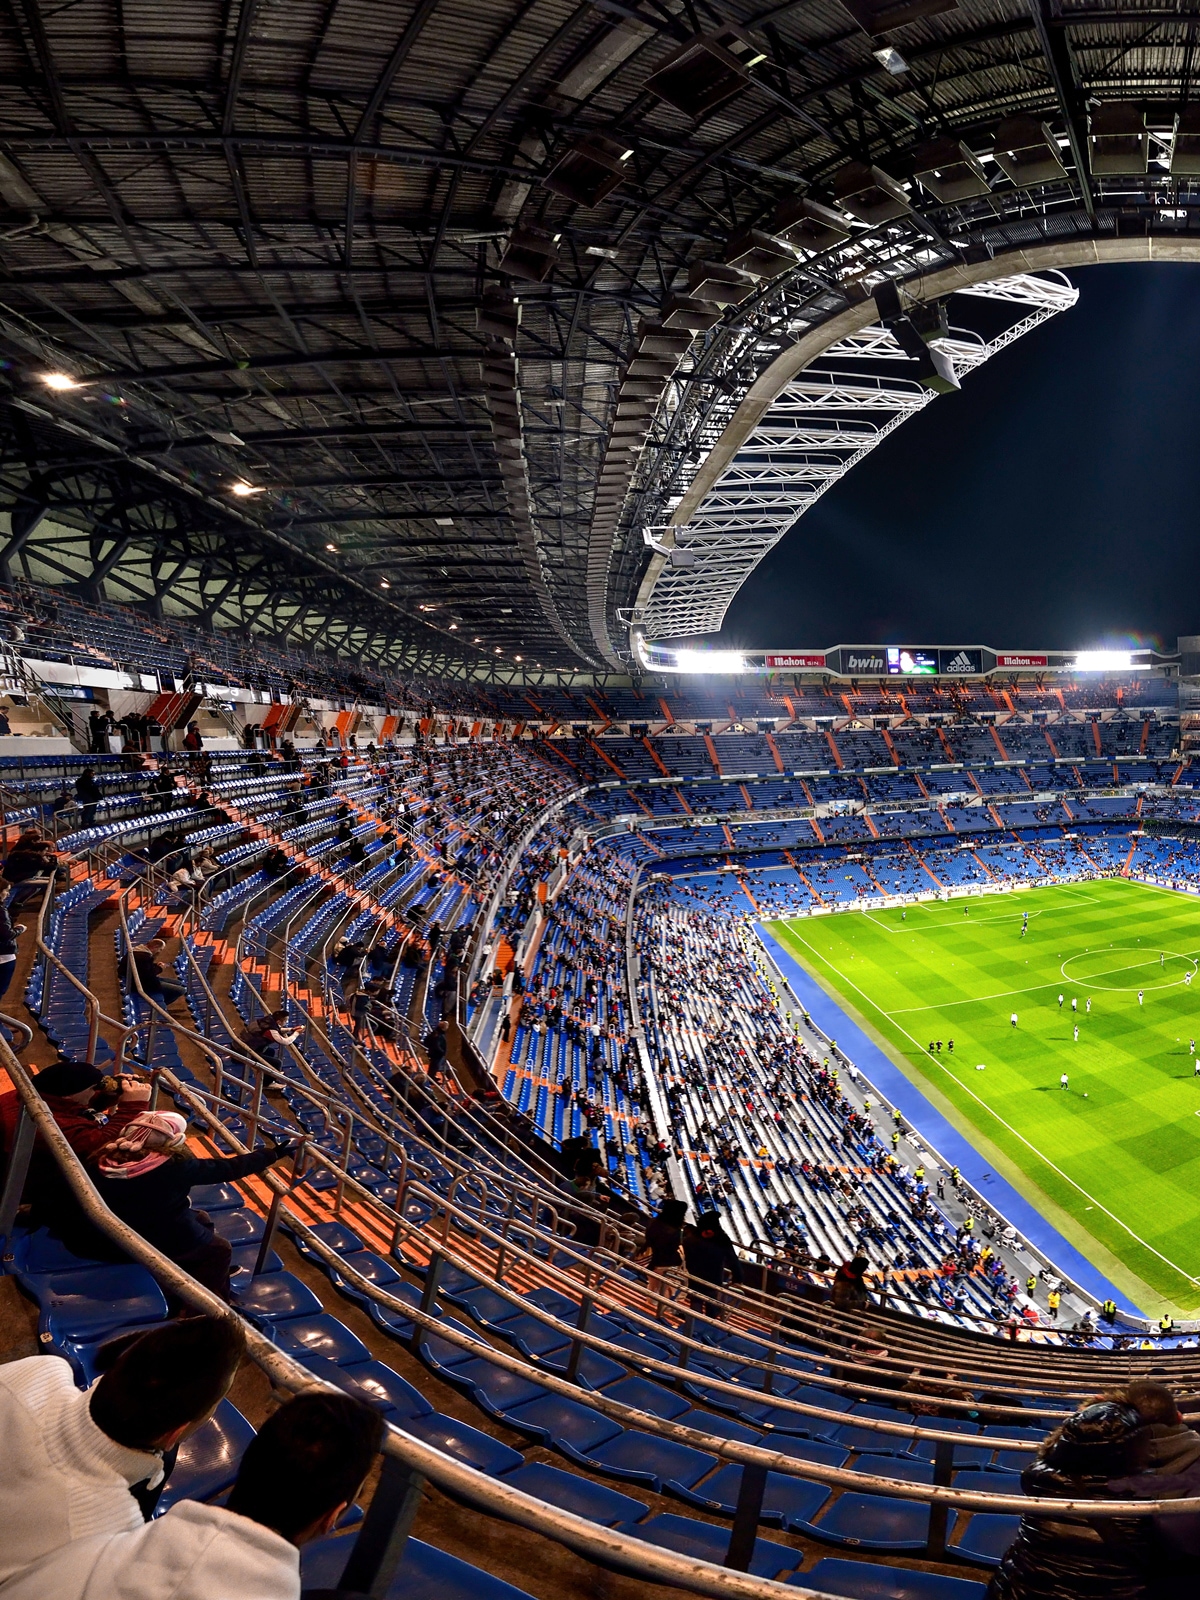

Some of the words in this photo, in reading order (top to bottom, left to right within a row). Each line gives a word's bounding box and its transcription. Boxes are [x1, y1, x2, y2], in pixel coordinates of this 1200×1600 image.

[774, 657, 805, 666] Mahou
[848, 655, 883, 668] bwin
[1004, 657, 1030, 665] Mahou
[946, 664, 975, 672] adidas
